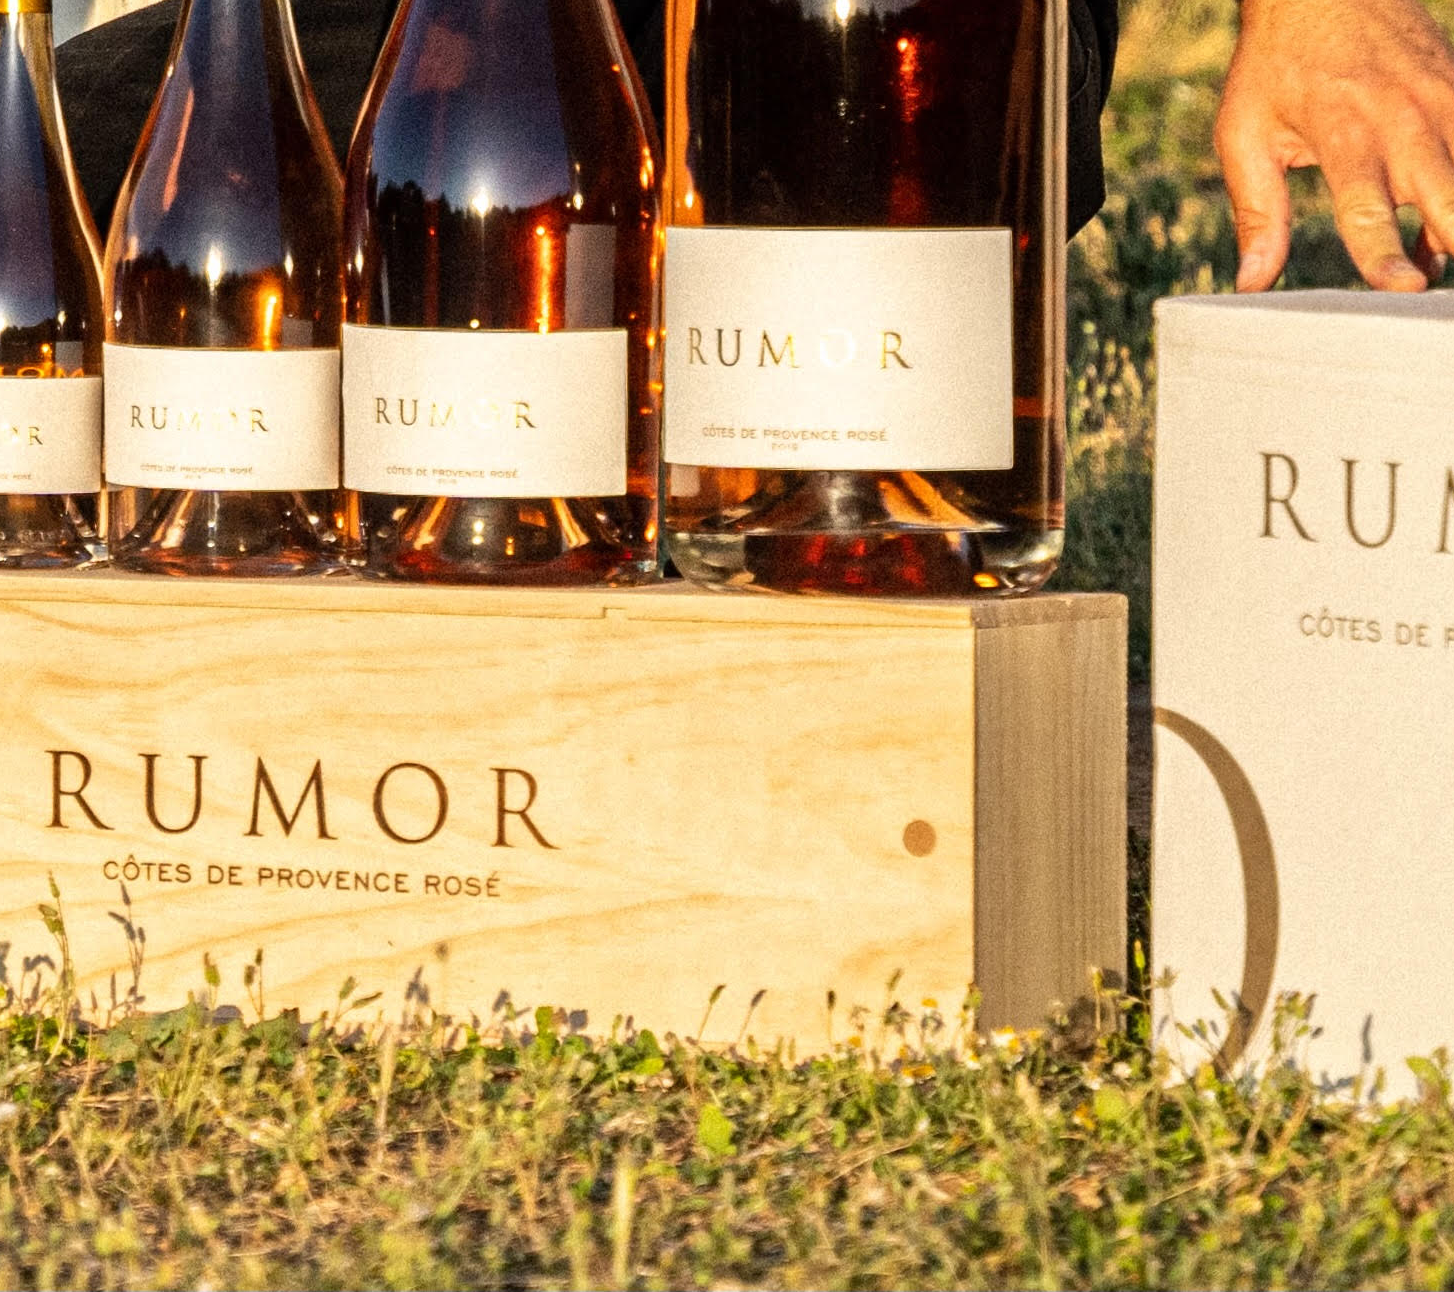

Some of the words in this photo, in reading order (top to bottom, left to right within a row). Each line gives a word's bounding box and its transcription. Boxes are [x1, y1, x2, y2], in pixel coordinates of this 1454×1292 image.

[686, 325, 912, 370] RUMOR
[129, 403, 270, 433] RUMR
[372, 395, 536, 429] RUMR
[701, 423, 736, 439] CÔTES
[740, 427, 756, 439] DE
[762, 428, 838, 441] PROVENCE
[846, 429, 887, 442] ROSÉ
[1298, 606, 1383, 644] CÔTES
[1394, 621, 1430, 648] DE
[43, 747, 561, 852] RUMOR
[102, 854, 192, 883] CÔTES
[207, 864, 244, 887] DE
[256, 866, 410, 894] PROVENCE
[424, 872, 501, 898] ROSÉ
